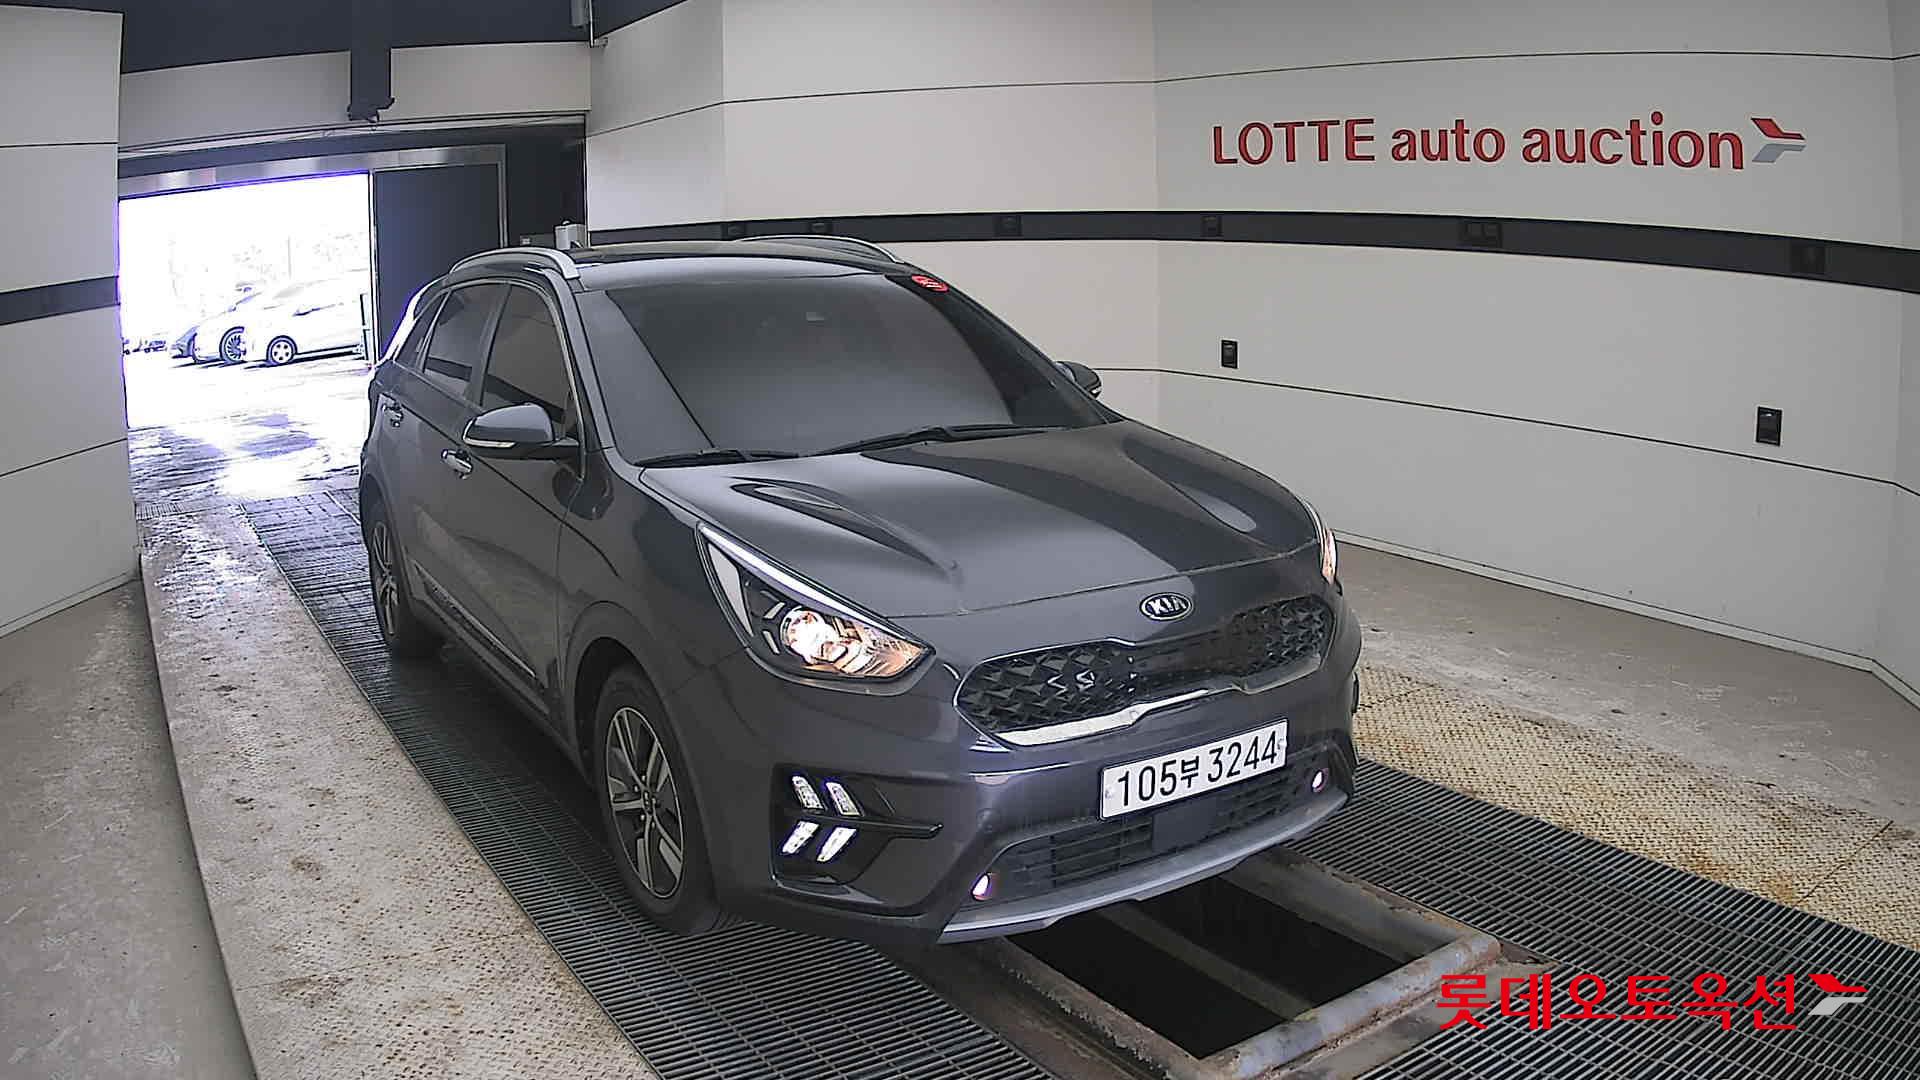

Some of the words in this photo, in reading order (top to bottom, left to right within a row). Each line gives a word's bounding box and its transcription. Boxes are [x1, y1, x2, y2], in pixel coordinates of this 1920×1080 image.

[1212, 118, 1375, 165] LOTTE
[1391, 119, 1507, 163] auto
[1522, 111, 1744, 170] auction
[1147, 596, 1187, 615] KIA
[1118, 755, 1200, 806] 105부
[1207, 730, 1278, 782] 3244
